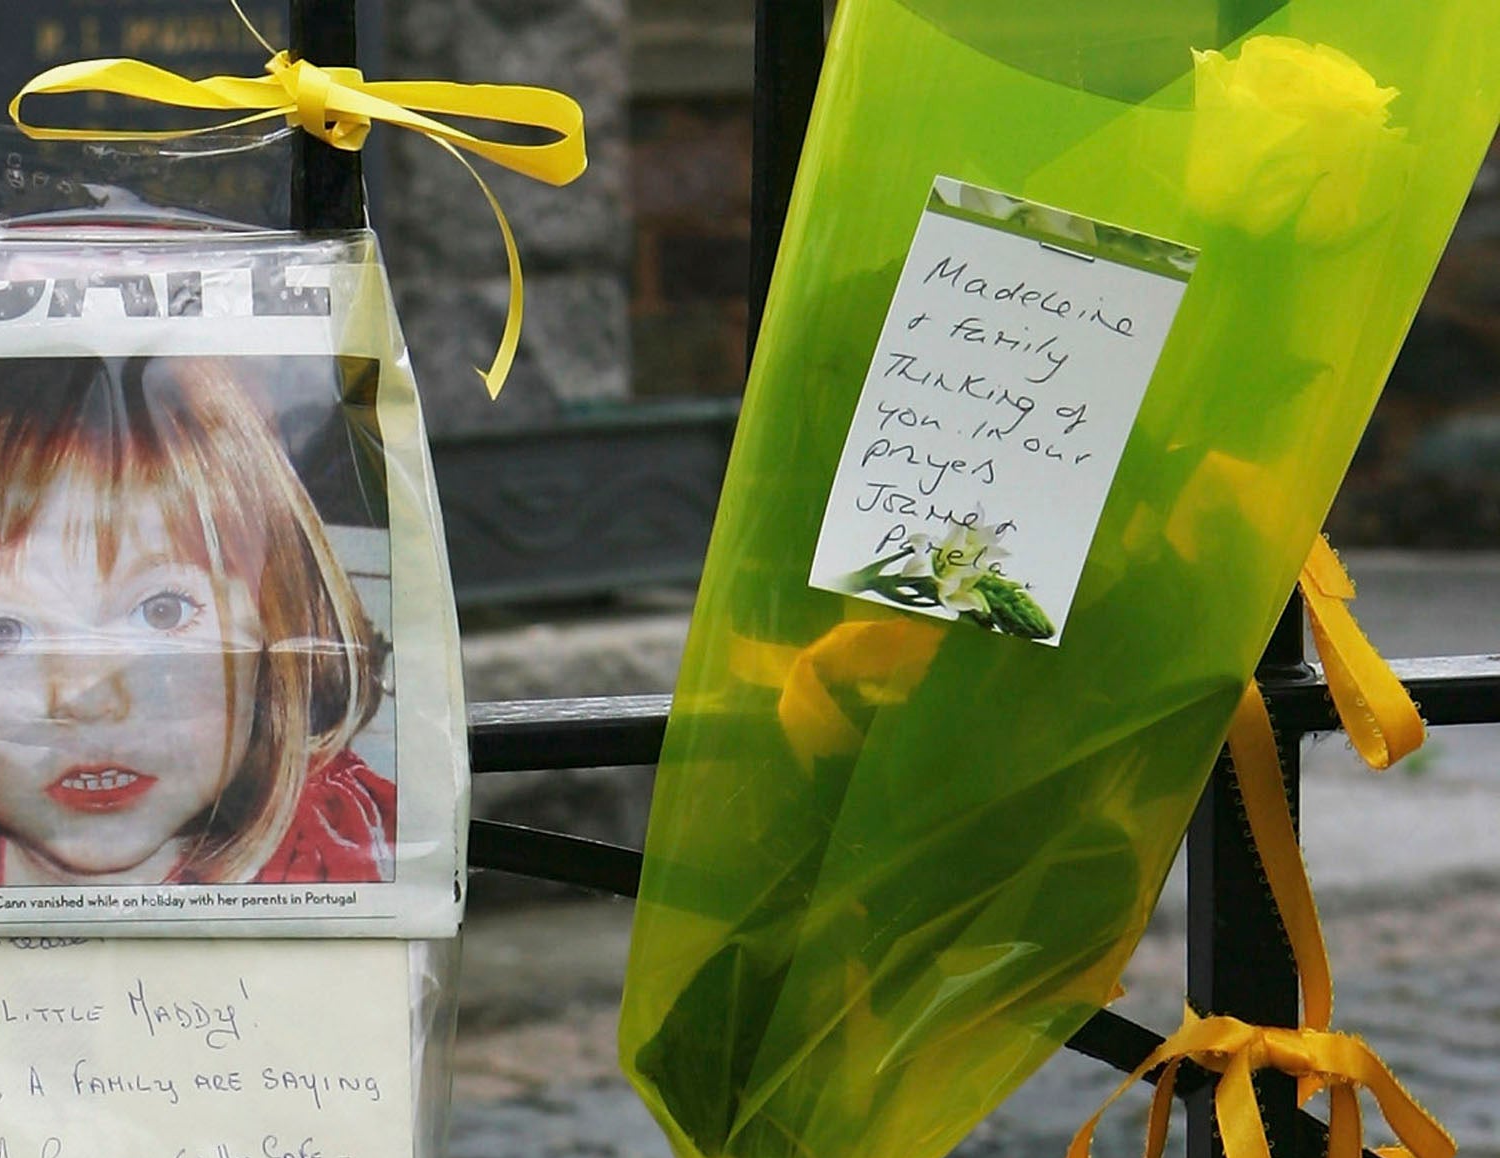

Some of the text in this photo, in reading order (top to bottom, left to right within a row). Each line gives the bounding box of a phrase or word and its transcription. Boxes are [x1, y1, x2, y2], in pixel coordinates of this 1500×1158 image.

[923, 256, 1135, 338] Madeleine
[883, 352, 1036, 435] Thinking
[29, 895, 84, 909] vanished
[87, 895, 120, 908] while
[122, 898, 139, 908] on
[141, 894, 186, 909] holiday
[188, 893, 215, 907] with
[217, 893, 240, 907] her
[241, 894, 289, 909] parents
[290, 893, 303, 906] in
[305, 891, 358, 907] Portugal
[1, 998, 105, 1024] LITTLE
[29, 1065, 46, 1097] A
[194, 1071, 244, 1093] ARE
